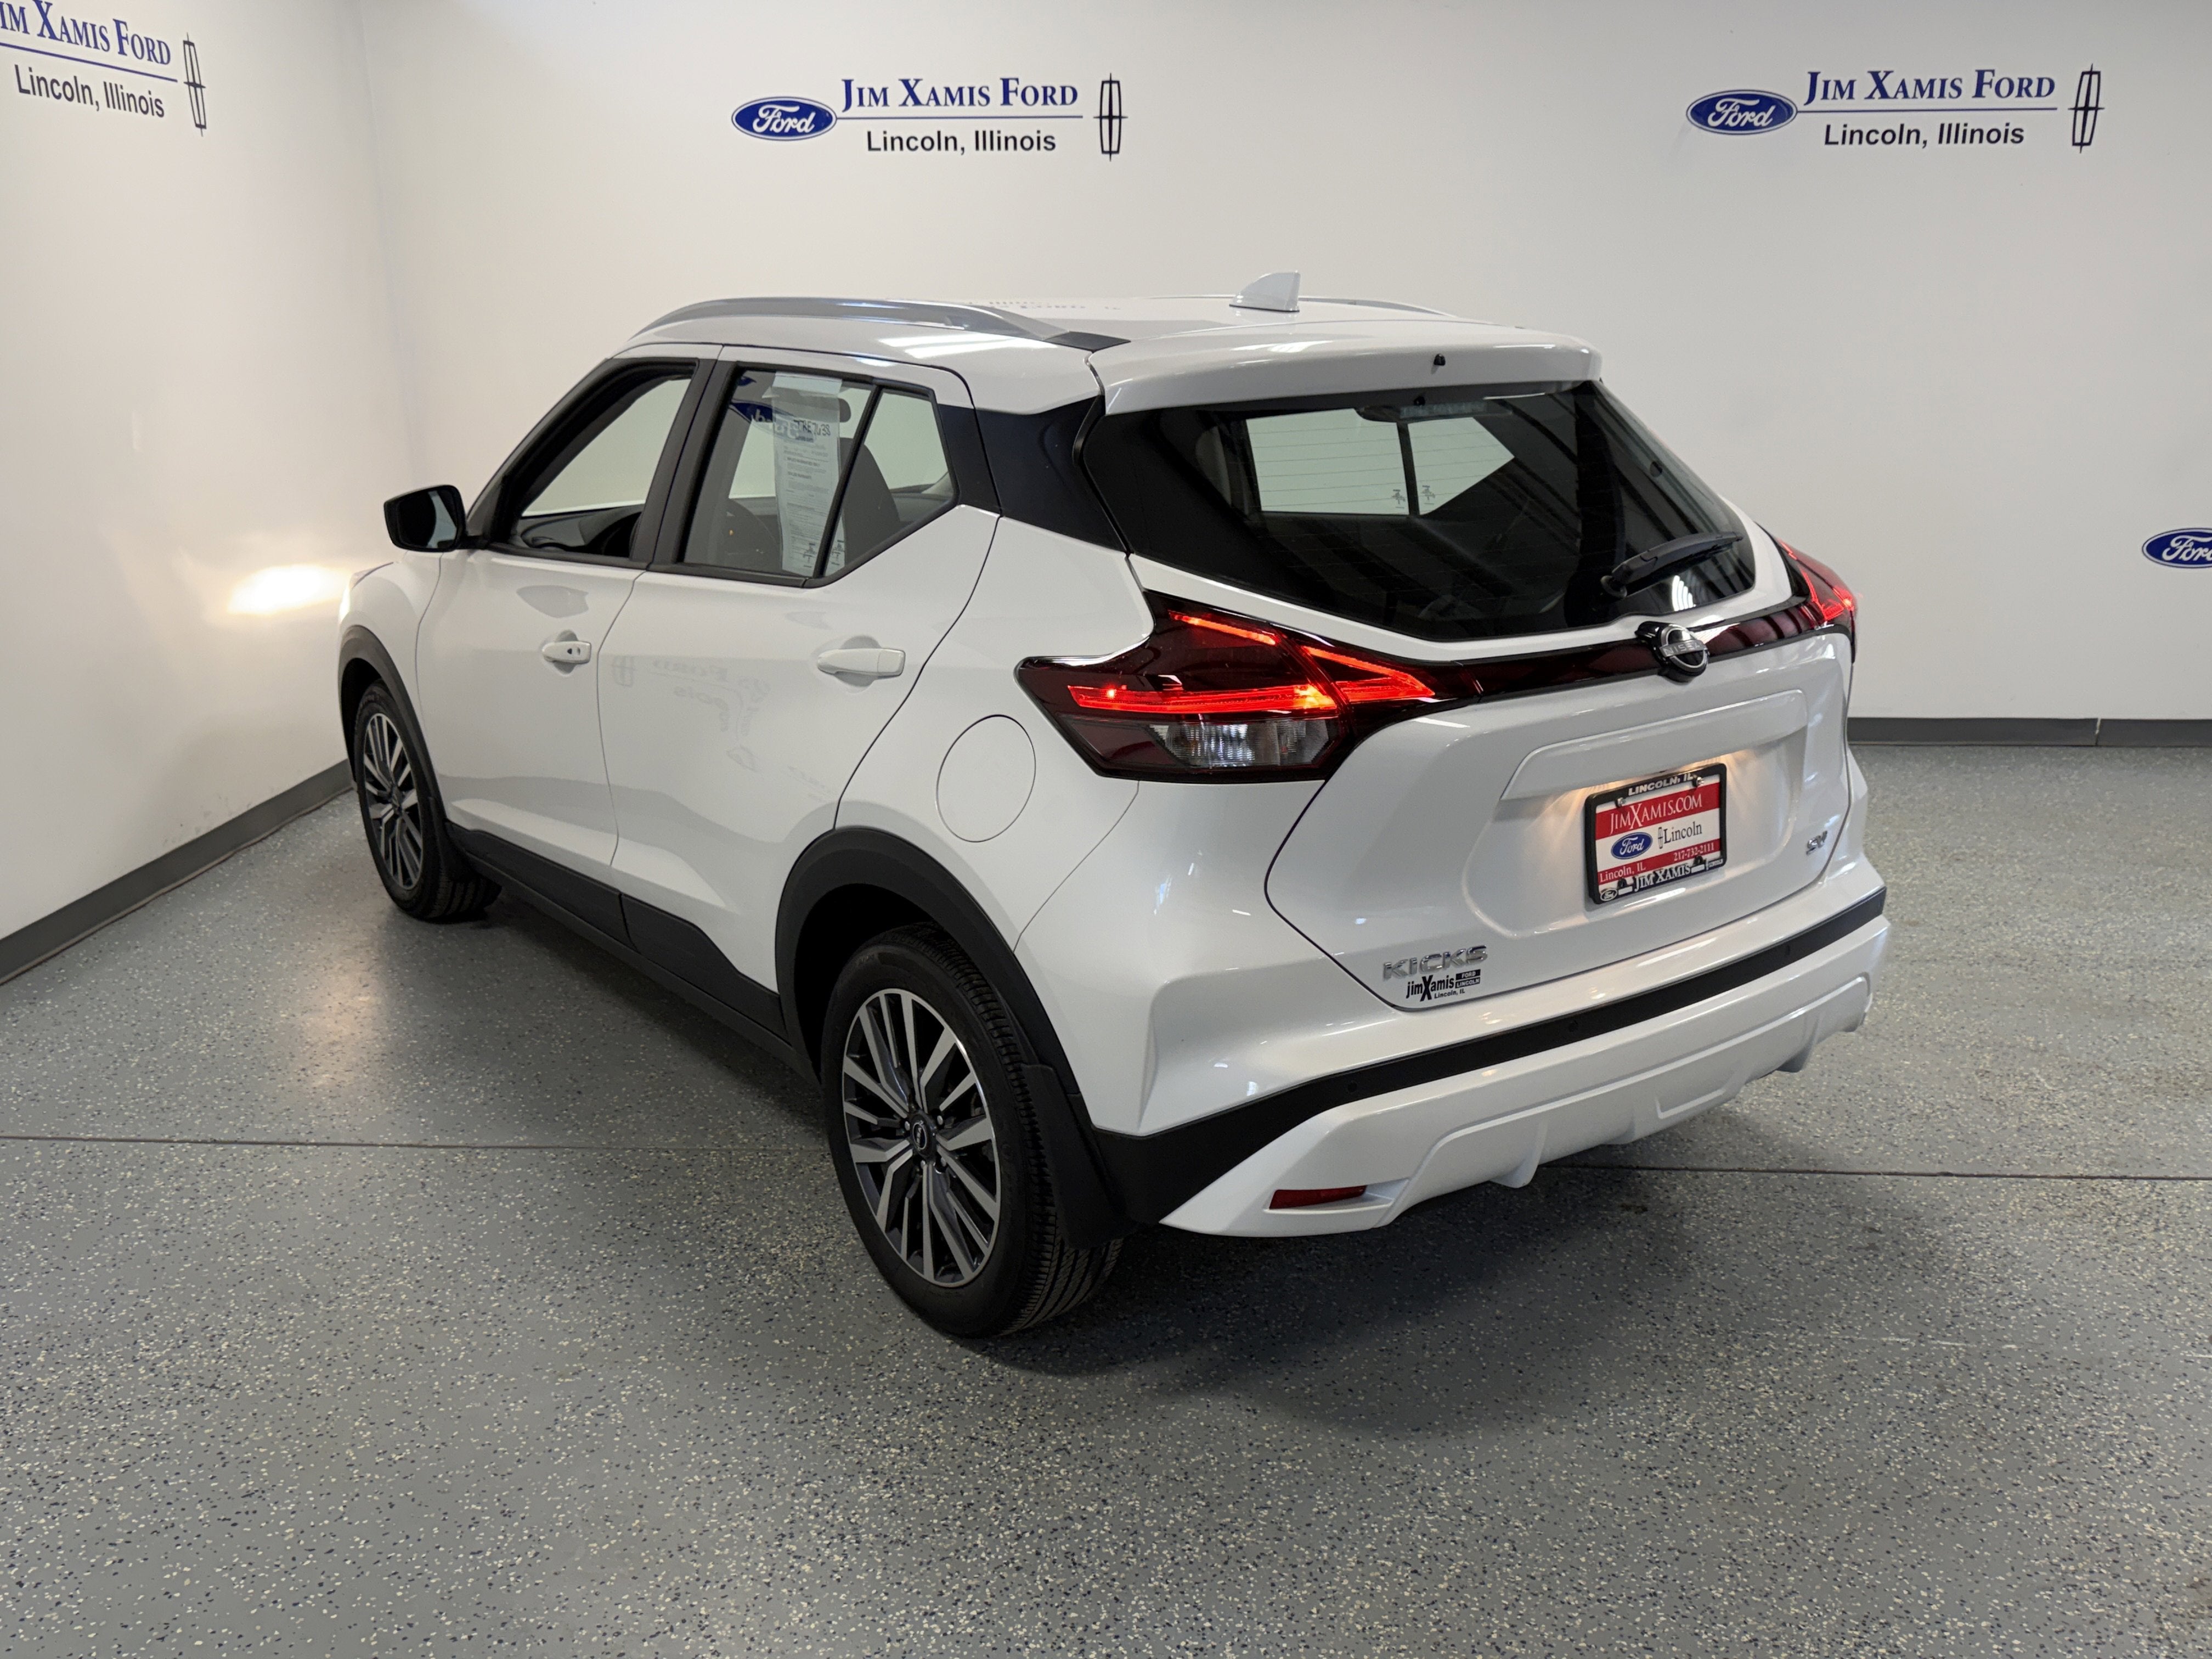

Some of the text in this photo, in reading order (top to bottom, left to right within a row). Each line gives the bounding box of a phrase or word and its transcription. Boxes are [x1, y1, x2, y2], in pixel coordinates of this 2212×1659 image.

[0, 0, 171, 65] IM XAMIS FORD
[14, 64, 165, 118] Lincoln, Illinois
[841, 77, 1078, 112] JIM XAMIS FORD
[1804, 69, 2056, 105] JIM XAMIS FORD
[752, 104, 816, 133] Ford
[1707, 98, 1776, 127] Ford
[866, 130, 1056, 154] Lincoln, Illinois
[1824, 123, 2025, 148] Lincoln, Illinois
[1662, 641, 1703, 657] NISSA
[1628, 773, 1694, 796] LINCOLN, IL
[1610, 793, 1702, 835] JIMXAMIS.COM
[1620, 836, 1645, 855] Ford
[1663, 821, 1702, 844] Lincoln
[1673, 842, 1715, 862] 217-732-2111
[1599, 862, 1646, 883] Lincoln, IL
[1634, 865, 1691, 892] JIM XAMIS
[1382, 945, 1488, 981] KICKS
[1456, 978, 1480, 988] LINCOLN
